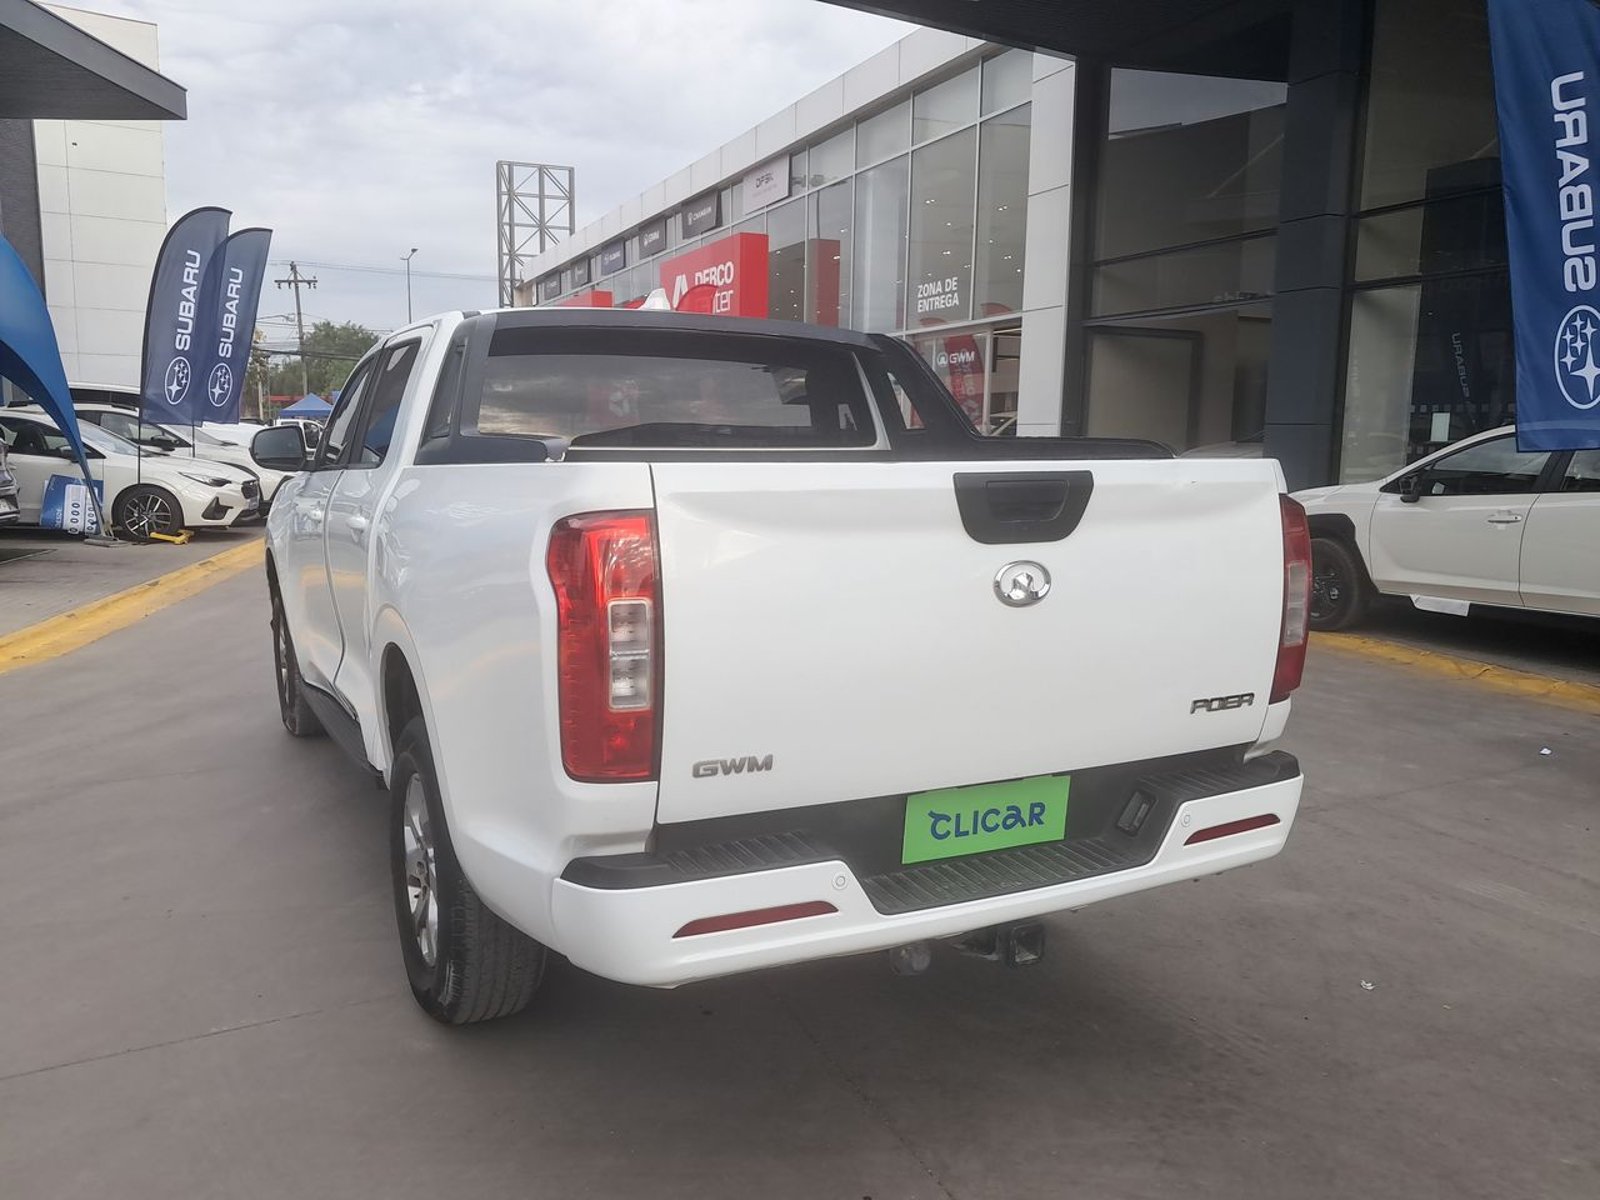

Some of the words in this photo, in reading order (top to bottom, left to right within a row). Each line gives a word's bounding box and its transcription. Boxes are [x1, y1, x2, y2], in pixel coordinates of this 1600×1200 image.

[917, 280, 943, 299] ZONA
[945, 276, 959, 292] DE
[175, 249, 201, 351] SUBARU
[917, 292, 960, 313] ENTREGA
[218, 266, 244, 359] SUBARU
[949, 350, 976, 365] GWM
[1190, 692, 1255, 714] POER
[692, 753, 774, 779] GWM
